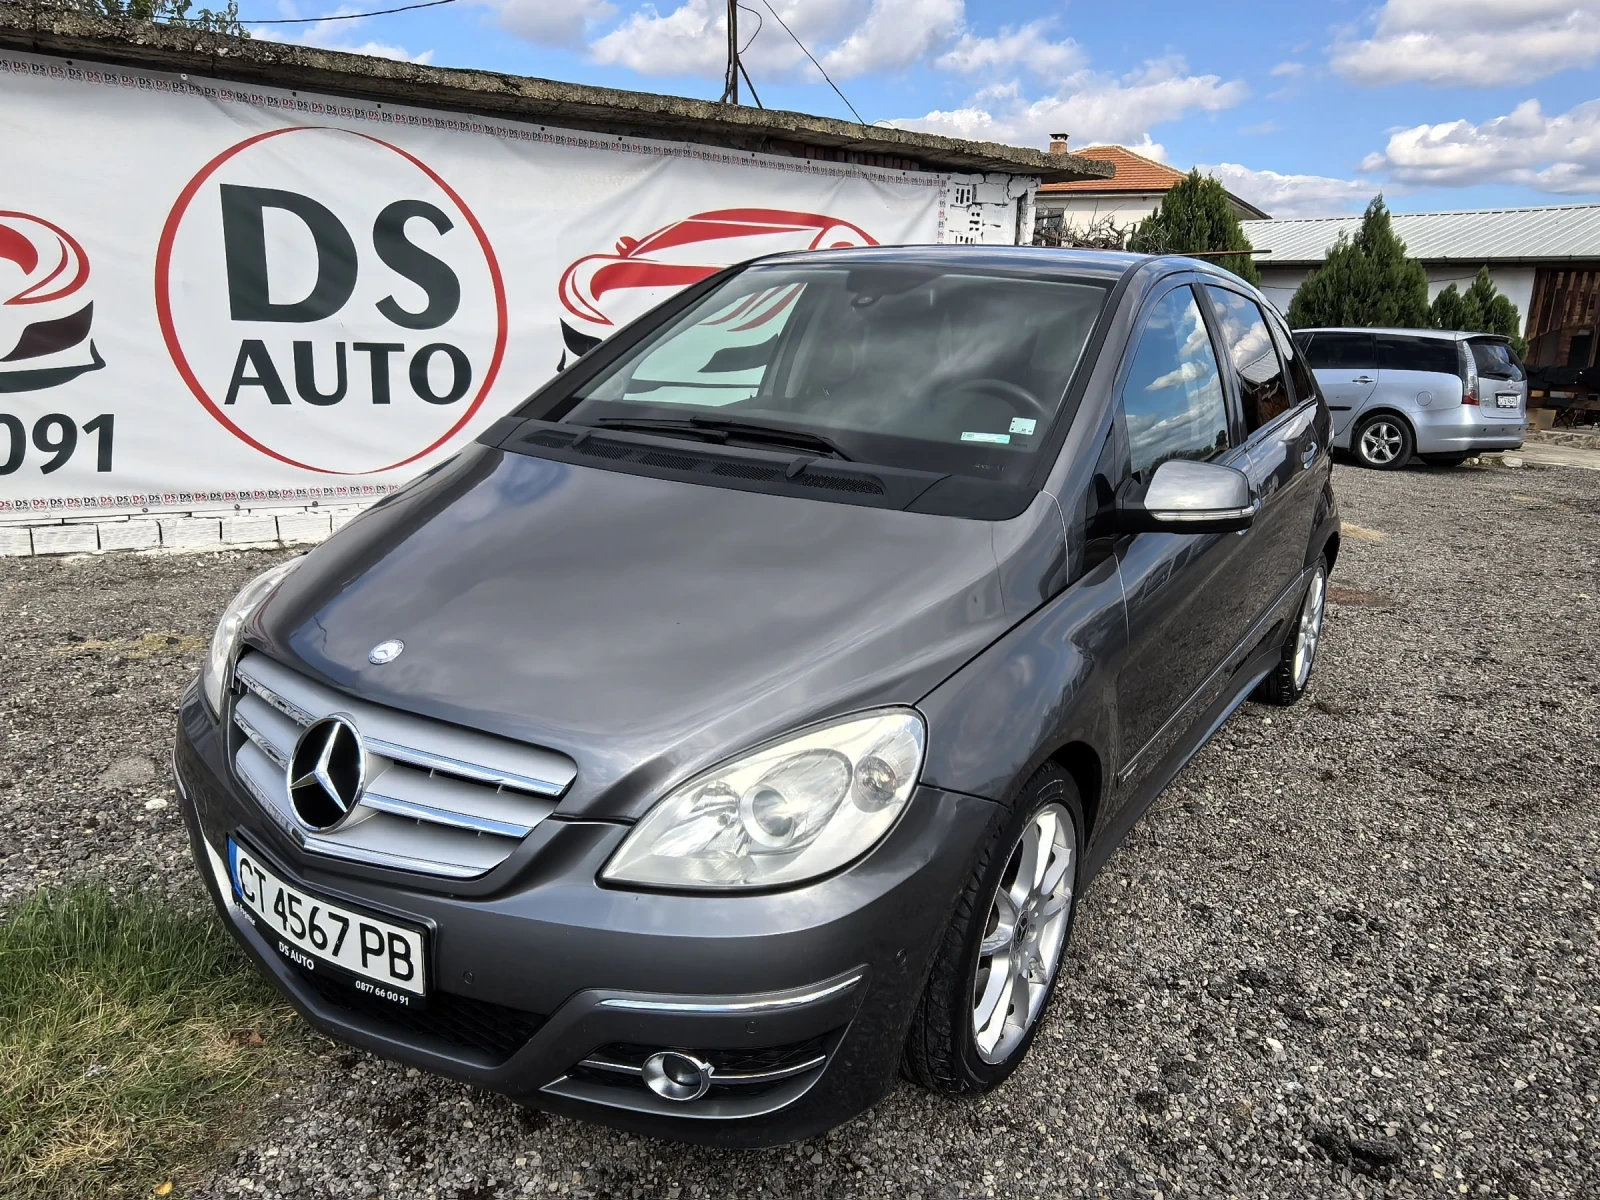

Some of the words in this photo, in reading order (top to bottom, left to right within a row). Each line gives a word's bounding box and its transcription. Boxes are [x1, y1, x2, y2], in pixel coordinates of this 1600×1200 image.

[13, 61, 27, 70] DS
[31, 63, 45, 73] DS
[50, 66, 64, 75] DS
[68, 68, 82, 77] DS
[86, 71, 100, 80] DS
[104, 73, 118, 82] DS
[121, 75, 135, 84] DS
[138, 77, 152, 86] DS
[156, 80, 168, 88] DS
[172, 82, 185, 90] DS
[204, 87, 217, 96] DS
[220, 90, 233, 98] DS
[251, 94, 264, 102] DS
[267, 96, 279, 105] DS
[282, 99, 294, 107] DS
[297, 101, 309, 109] DS
[311, 103, 323, 111] DS
[355, 108, 365, 116] DS
[368, 110, 379, 118] DS
[382, 112, 393, 120] DS
[409, 115, 419, 124] DS
[422, 117, 433, 125] DS
[448, 120, 458, 128] DS
[460, 121, 470, 129] DS
[472, 123, 482, 131] DS
[484, 125, 494, 133] DS
[497, 127, 506, 135] DS
[520, 130, 530, 138] DS
[544, 133, 554, 141] DS
[589, 139, 598, 147] DS
[600, 141, 609, 149] DS
[611, 142, 620, 150] DS
[621, 143, 630, 151] DS
[643, 146, 652, 154] DS
[219, 184, 461, 331] DS
[224, 339, 472, 406] AUTO
[15, 499, 28, 508] DS
[50, 498, 63, 506] DS
[67, 497, 80, 505] DS
[84, 496, 96, 504] DS
[100, 496, 112, 504] DS
[116, 495, 129, 503] DS
[132, 494, 145, 502] DS
[148, 494, 160, 502] DS
[225, 491, 236, 499] DS
[240, 858, 267, 914] CT
[273, 888, 350, 957] 4567
[360, 922, 415, 982] PB
[278, 942, 290, 957] DS
[290, 951, 315, 971] AUTO
[355, 980, 375, 995] 0877
[375, 987, 386, 998] 66
[386, 991, 398, 1003] 00
[399, 995, 409, 1006] 91
